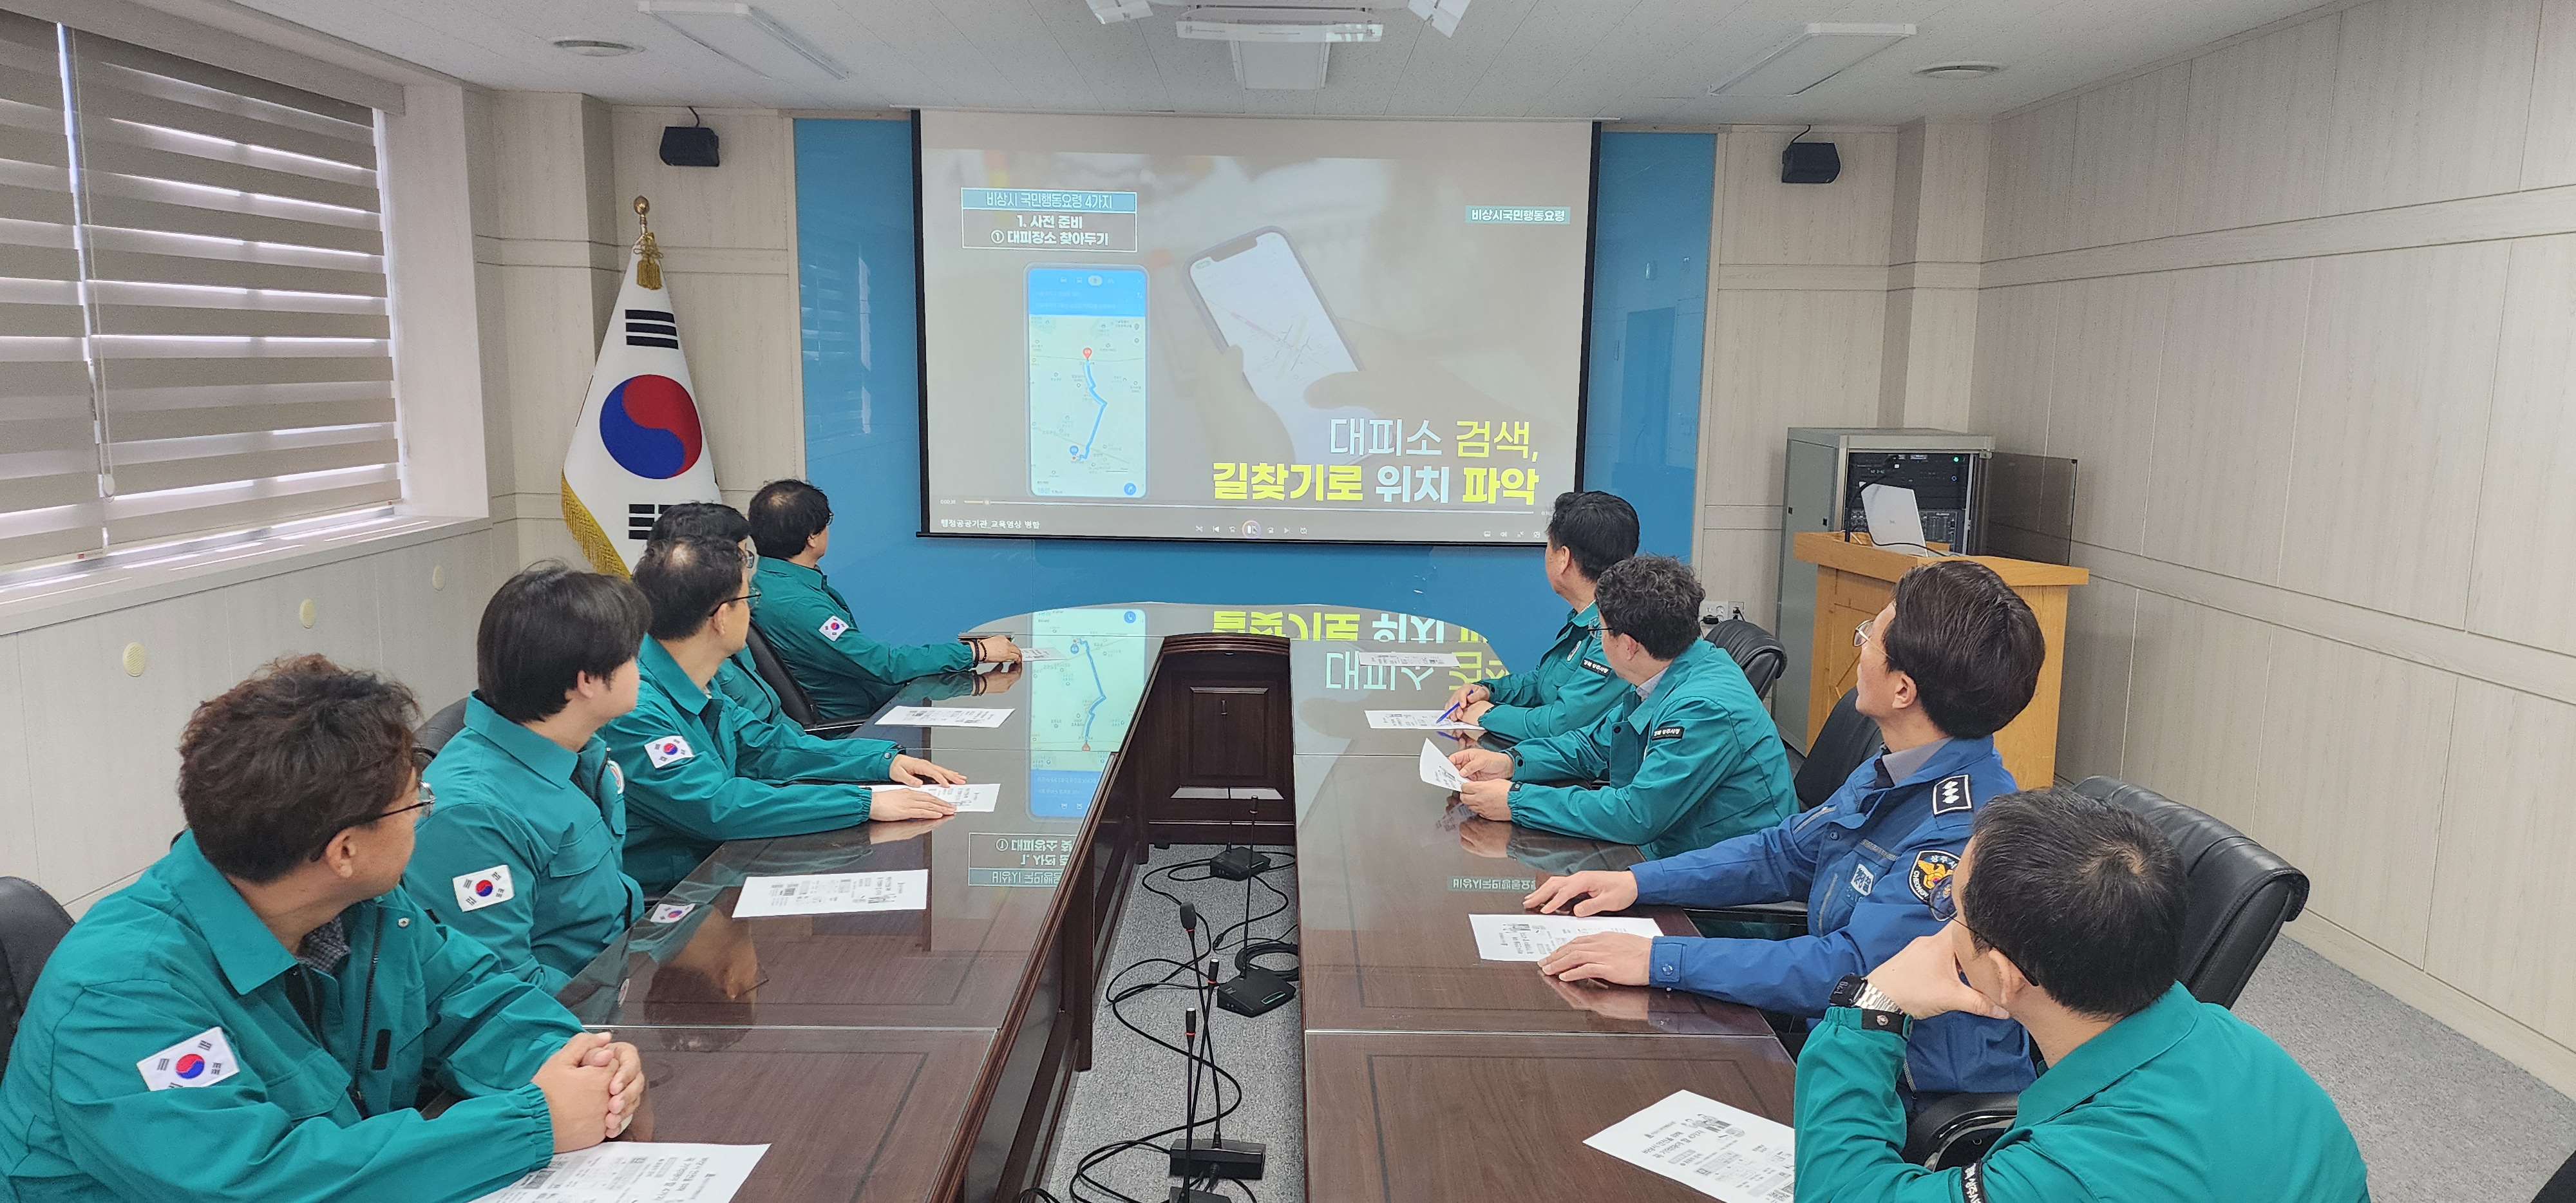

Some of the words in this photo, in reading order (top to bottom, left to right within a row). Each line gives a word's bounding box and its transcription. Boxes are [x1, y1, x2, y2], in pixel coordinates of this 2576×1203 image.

[985, 192, 1018, 207] 비상시
[1020, 193, 1083, 209] 국민행동요령
[1084, 194, 1113, 209] 4가지
[1016, 214, 1027, 227] 1.
[1030, 215, 1055, 229] 사전
[1057, 216, 1083, 229] 준비
[1472, 209, 1565, 222] 비상시국민행동요령
[1007, 231, 1057, 245] 대피장소
[1059, 232, 1109, 246] 찾아두기
[1330, 418, 1442, 457] 대피소
[1455, 421, 1539, 462] 검색,
[1213, 462, 1363, 502] 길찾기로
[1375, 465, 1450, 504] 위치
[1462, 466, 1540, 506] 파악
